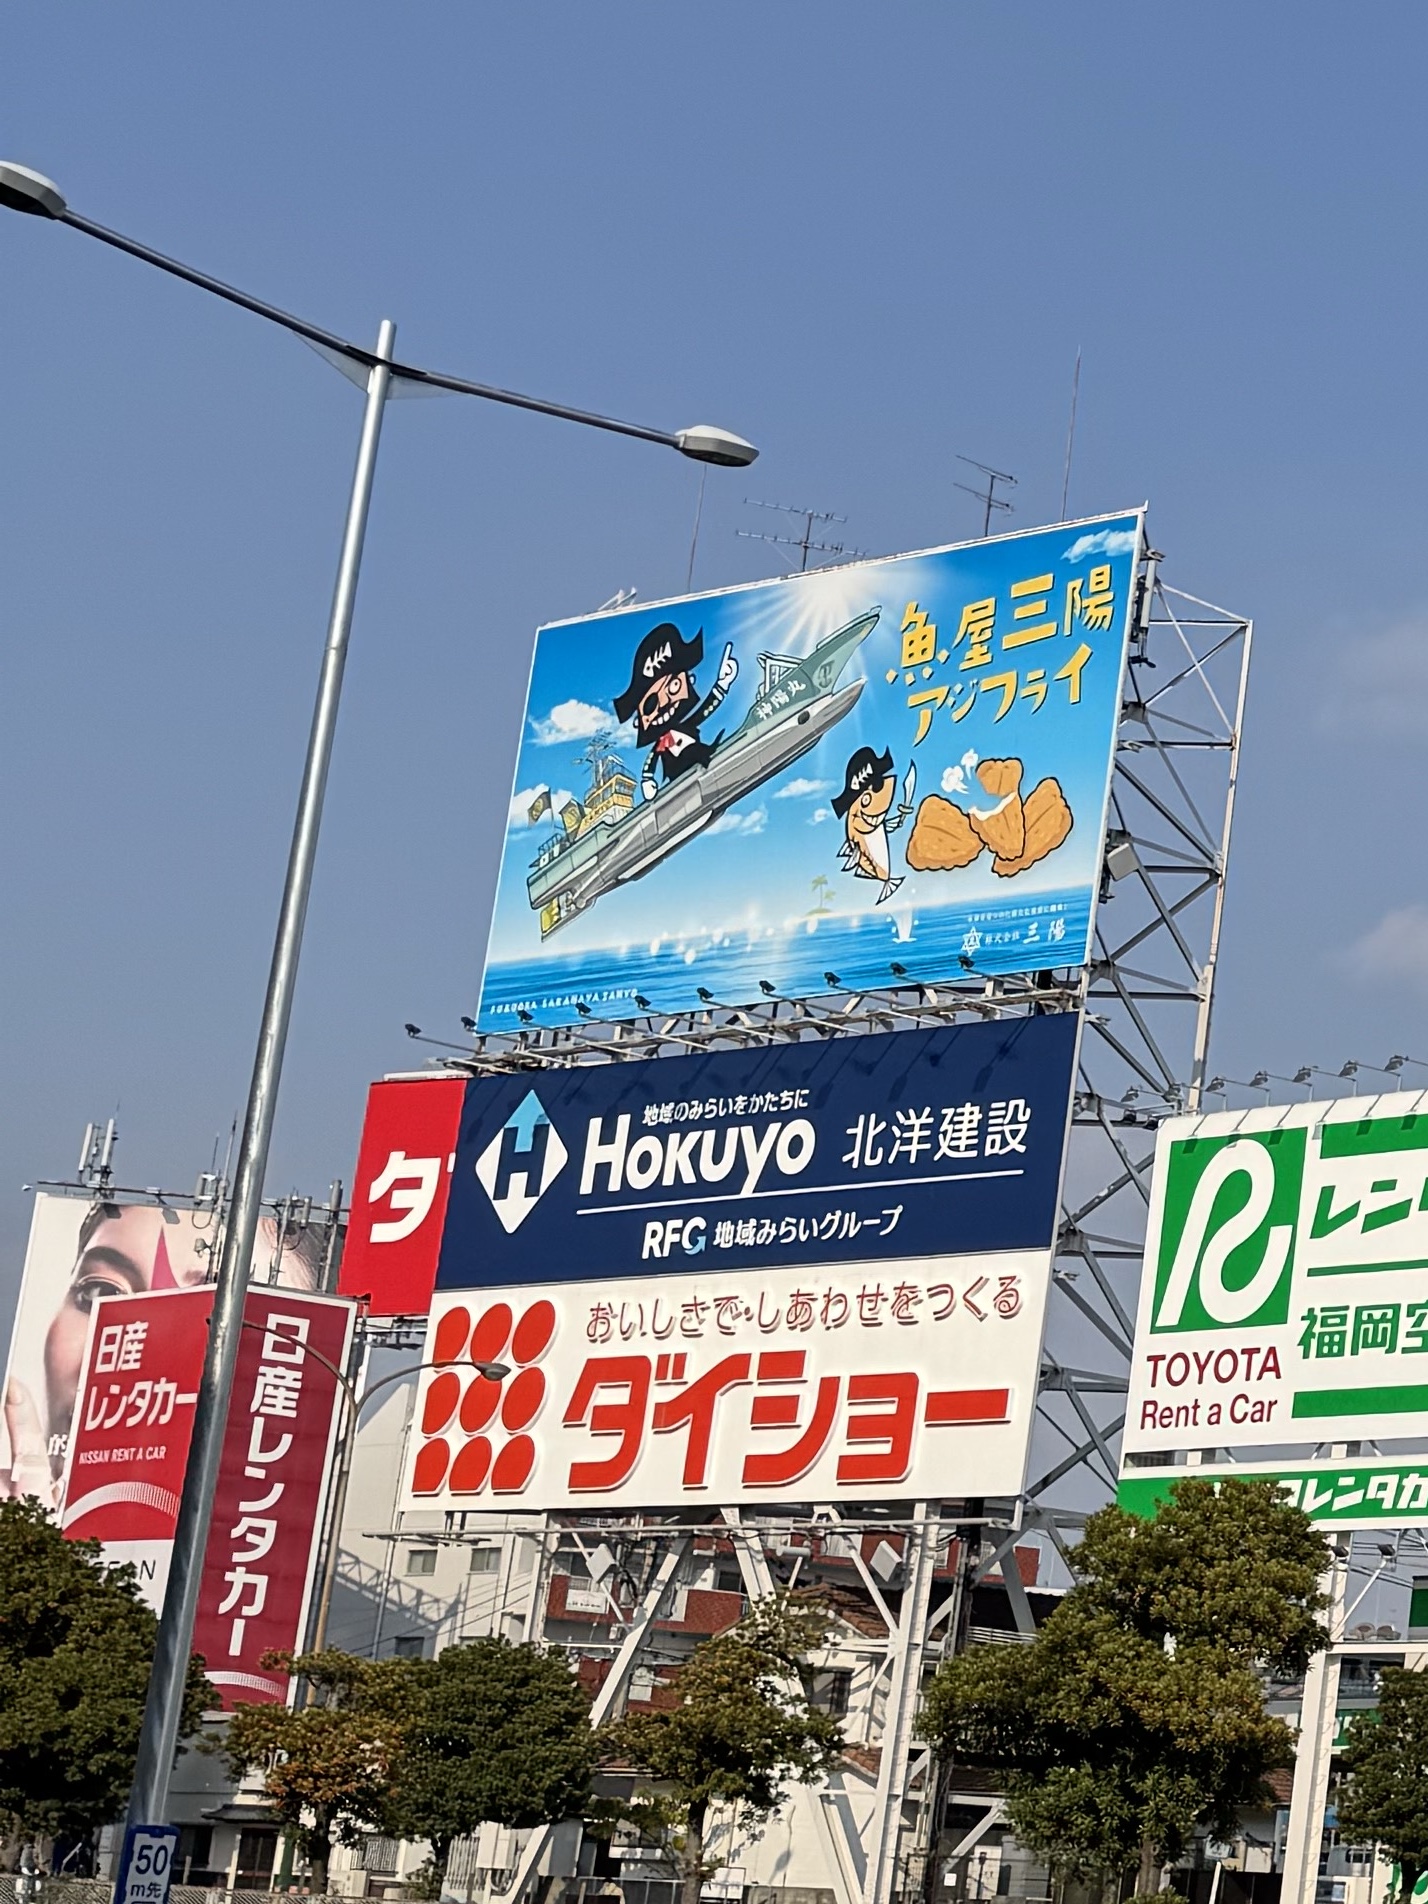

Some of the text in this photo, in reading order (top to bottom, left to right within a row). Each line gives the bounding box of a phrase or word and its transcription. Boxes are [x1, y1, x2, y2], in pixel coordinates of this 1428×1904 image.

[886, 564, 1114, 686] 魚屋三陽
[907, 643, 1094, 748] アジフライ
[602, 988, 638, 1002] SANYO
[641, 1088, 810, 1127] 地域のみらいをかたちに
[841, 1098, 1031, 1170] 北洋建設
[713, 1205, 904, 1249] 地域みらいグループ
[95, 1320, 149, 1374] 日産
[1146, 1346, 1282, 1389] TOYOTA
[85, 1377, 198, 1432] レンタカー
[562, 1349, 1011, 1494] ダイショー
[1140, 1393, 1278, 1430] Rent a Car
[79, 1446, 167, 1465] NISSAN RENT A CAR
[218, 1313, 309, 1656] 日産レンタカー
[135, 1844, 168, 1876] 50
